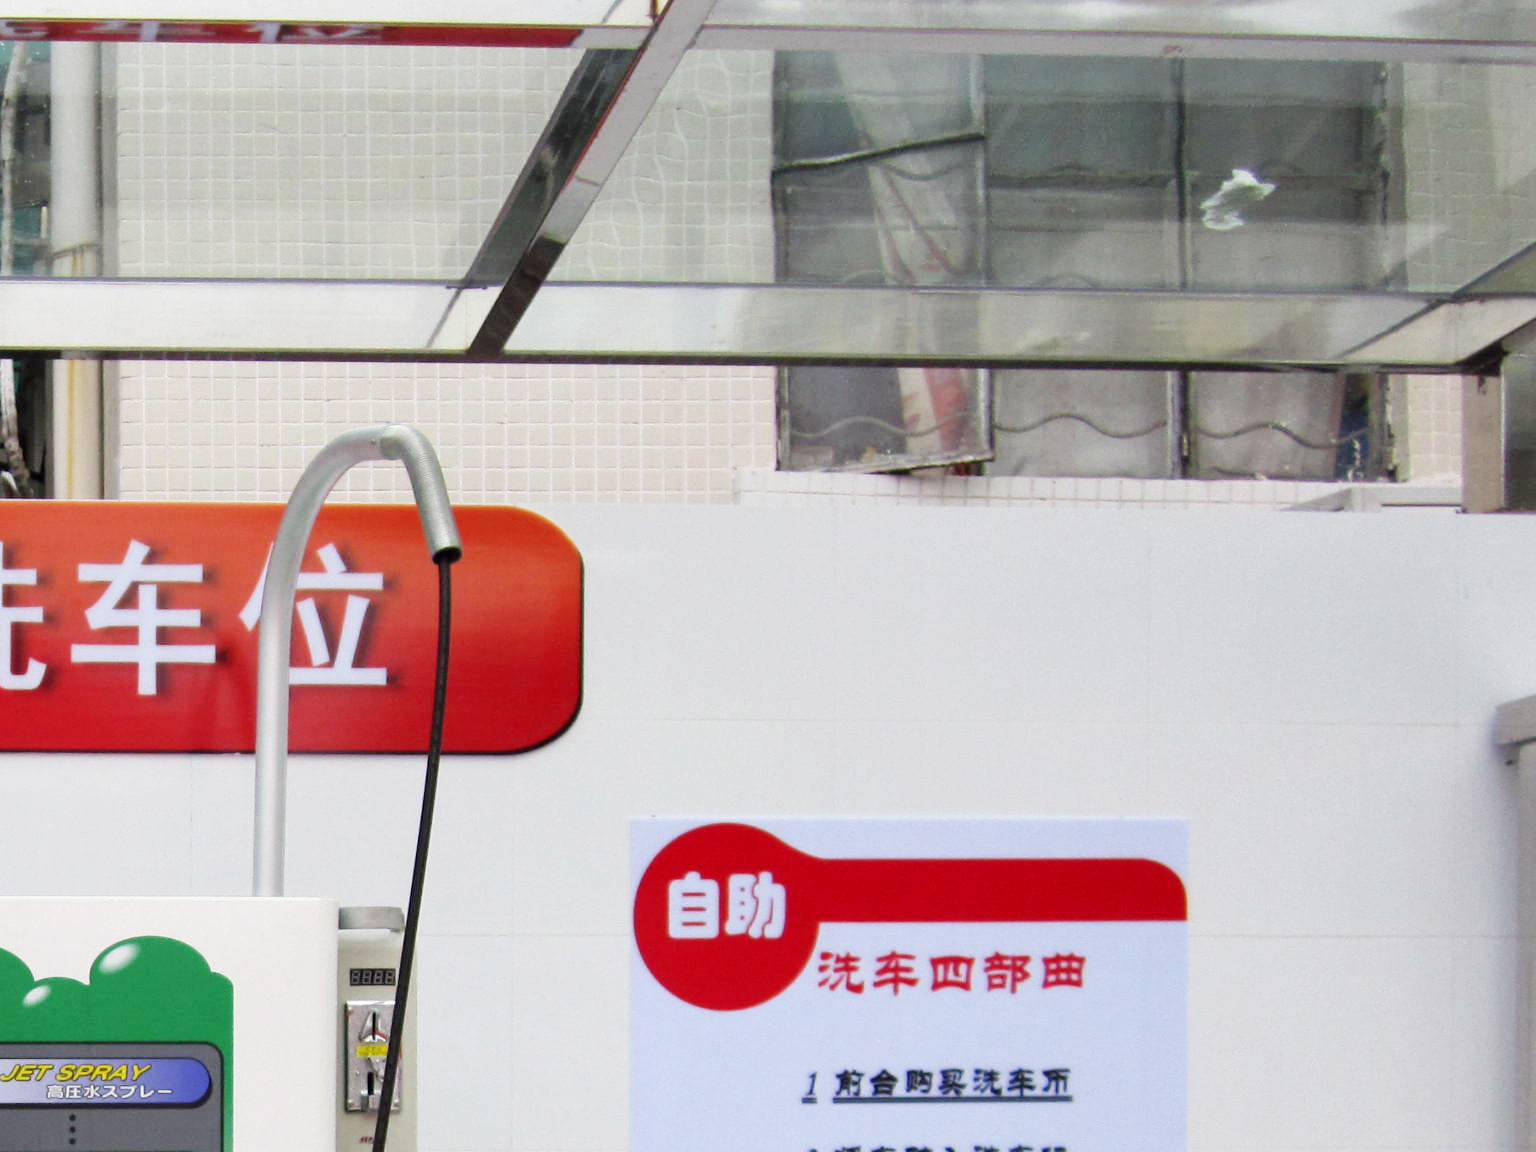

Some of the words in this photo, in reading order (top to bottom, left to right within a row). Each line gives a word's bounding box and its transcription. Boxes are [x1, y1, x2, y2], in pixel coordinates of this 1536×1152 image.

[667, 871, 786, 939] 自助
[818, 950, 1086, 996] 洗车四部曲
[0, 1064, 53, 1082] JET
[55, 1064, 152, 1082] SPRAY
[805, 1071, 818, 1096] 1
[47, 1084, 173, 1099] 高圧水スプレー
